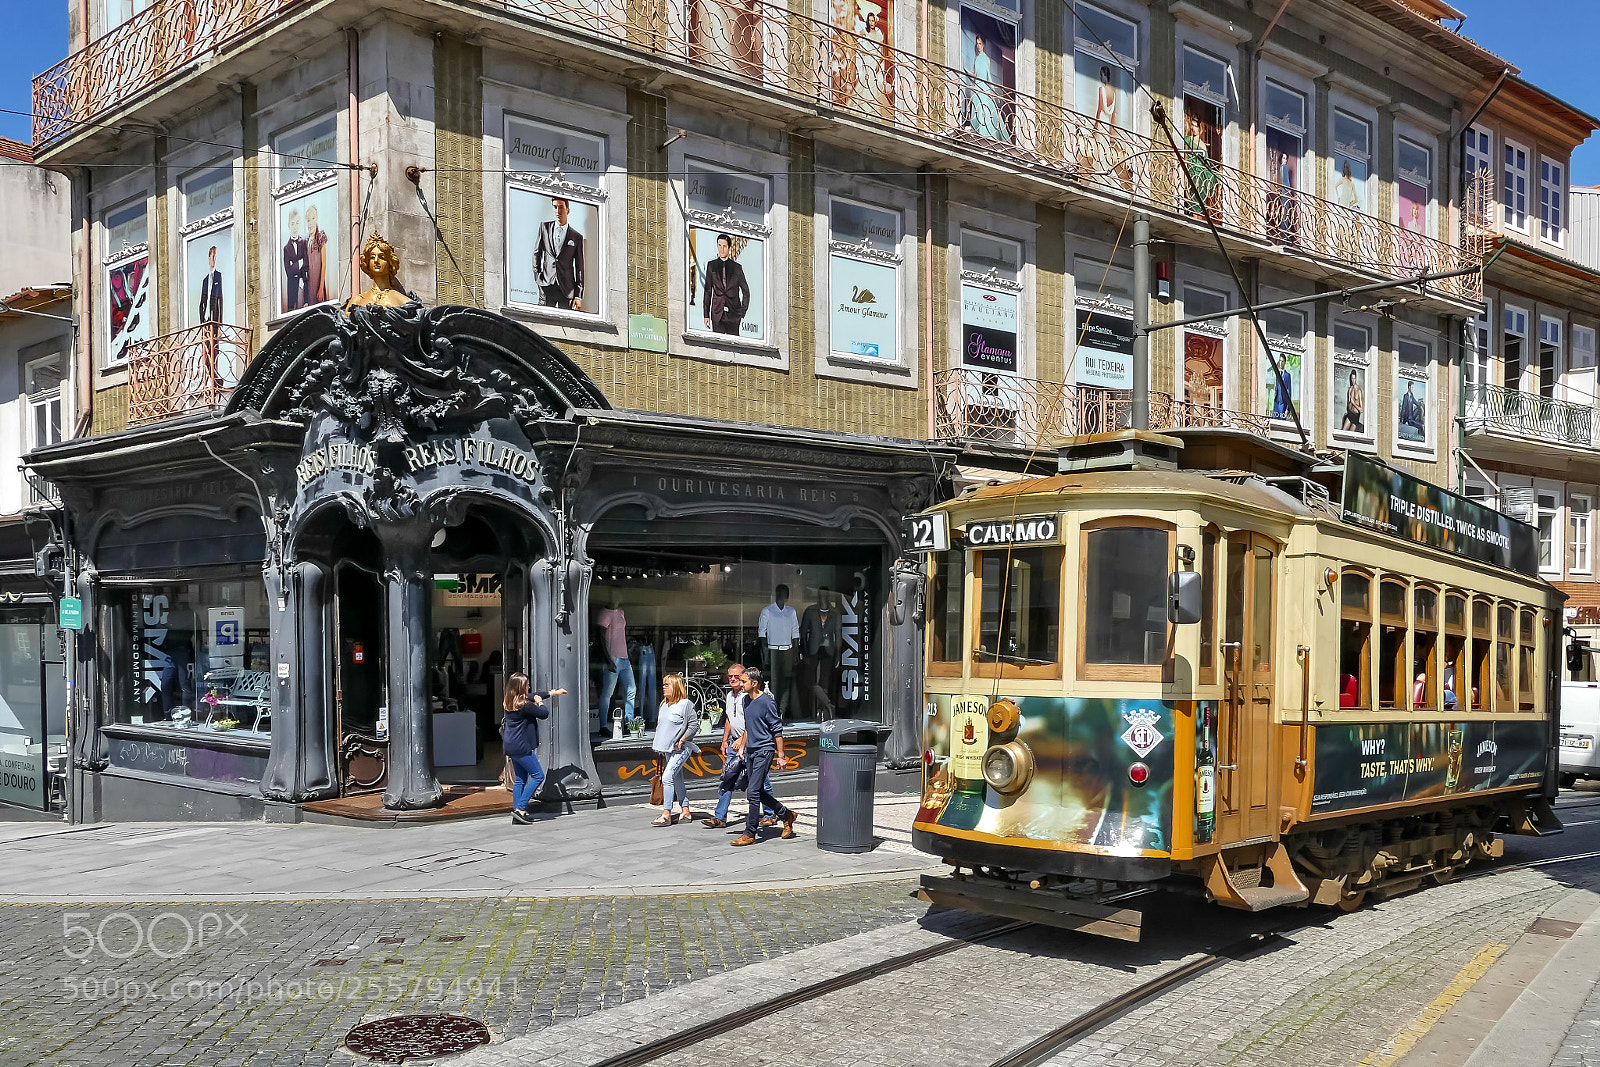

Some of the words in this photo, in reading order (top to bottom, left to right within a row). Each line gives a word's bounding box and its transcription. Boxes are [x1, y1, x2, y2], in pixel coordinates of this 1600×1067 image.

[510, 138, 551, 160] Amour
[552, 147, 599, 171] Glamour
[725, 187, 764, 209] Glamour
[862, 218, 895, 240] Glamour
[838, 304, 860, 315] Amour
[861, 307, 889, 319] Glamour
[967, 332, 1012, 358] Glamour
[981, 353, 1012, 365] eventus
[1085, 356, 1096, 369] RUI
[329, 443, 375, 474] FILHOS
[463, 437, 540, 481] FILHOS
[658, 477, 784, 500] OURIVESARIA
[800, 488, 838, 502] REIS
[1390, 494, 1420, 518] TRIPLE
[1416, 505, 1455, 532] DISTILLED.
[1455, 519, 1476, 538] TWICE
[1476, 526, 1486, 542] AS
[969, 520, 1055, 545] CARMO
[143, 594, 169, 705] SMK
[841, 590, 859, 700] SMK
[1361, 738, 1386, 756] WHY?
[1360, 761, 1387, 779] TASTE,
